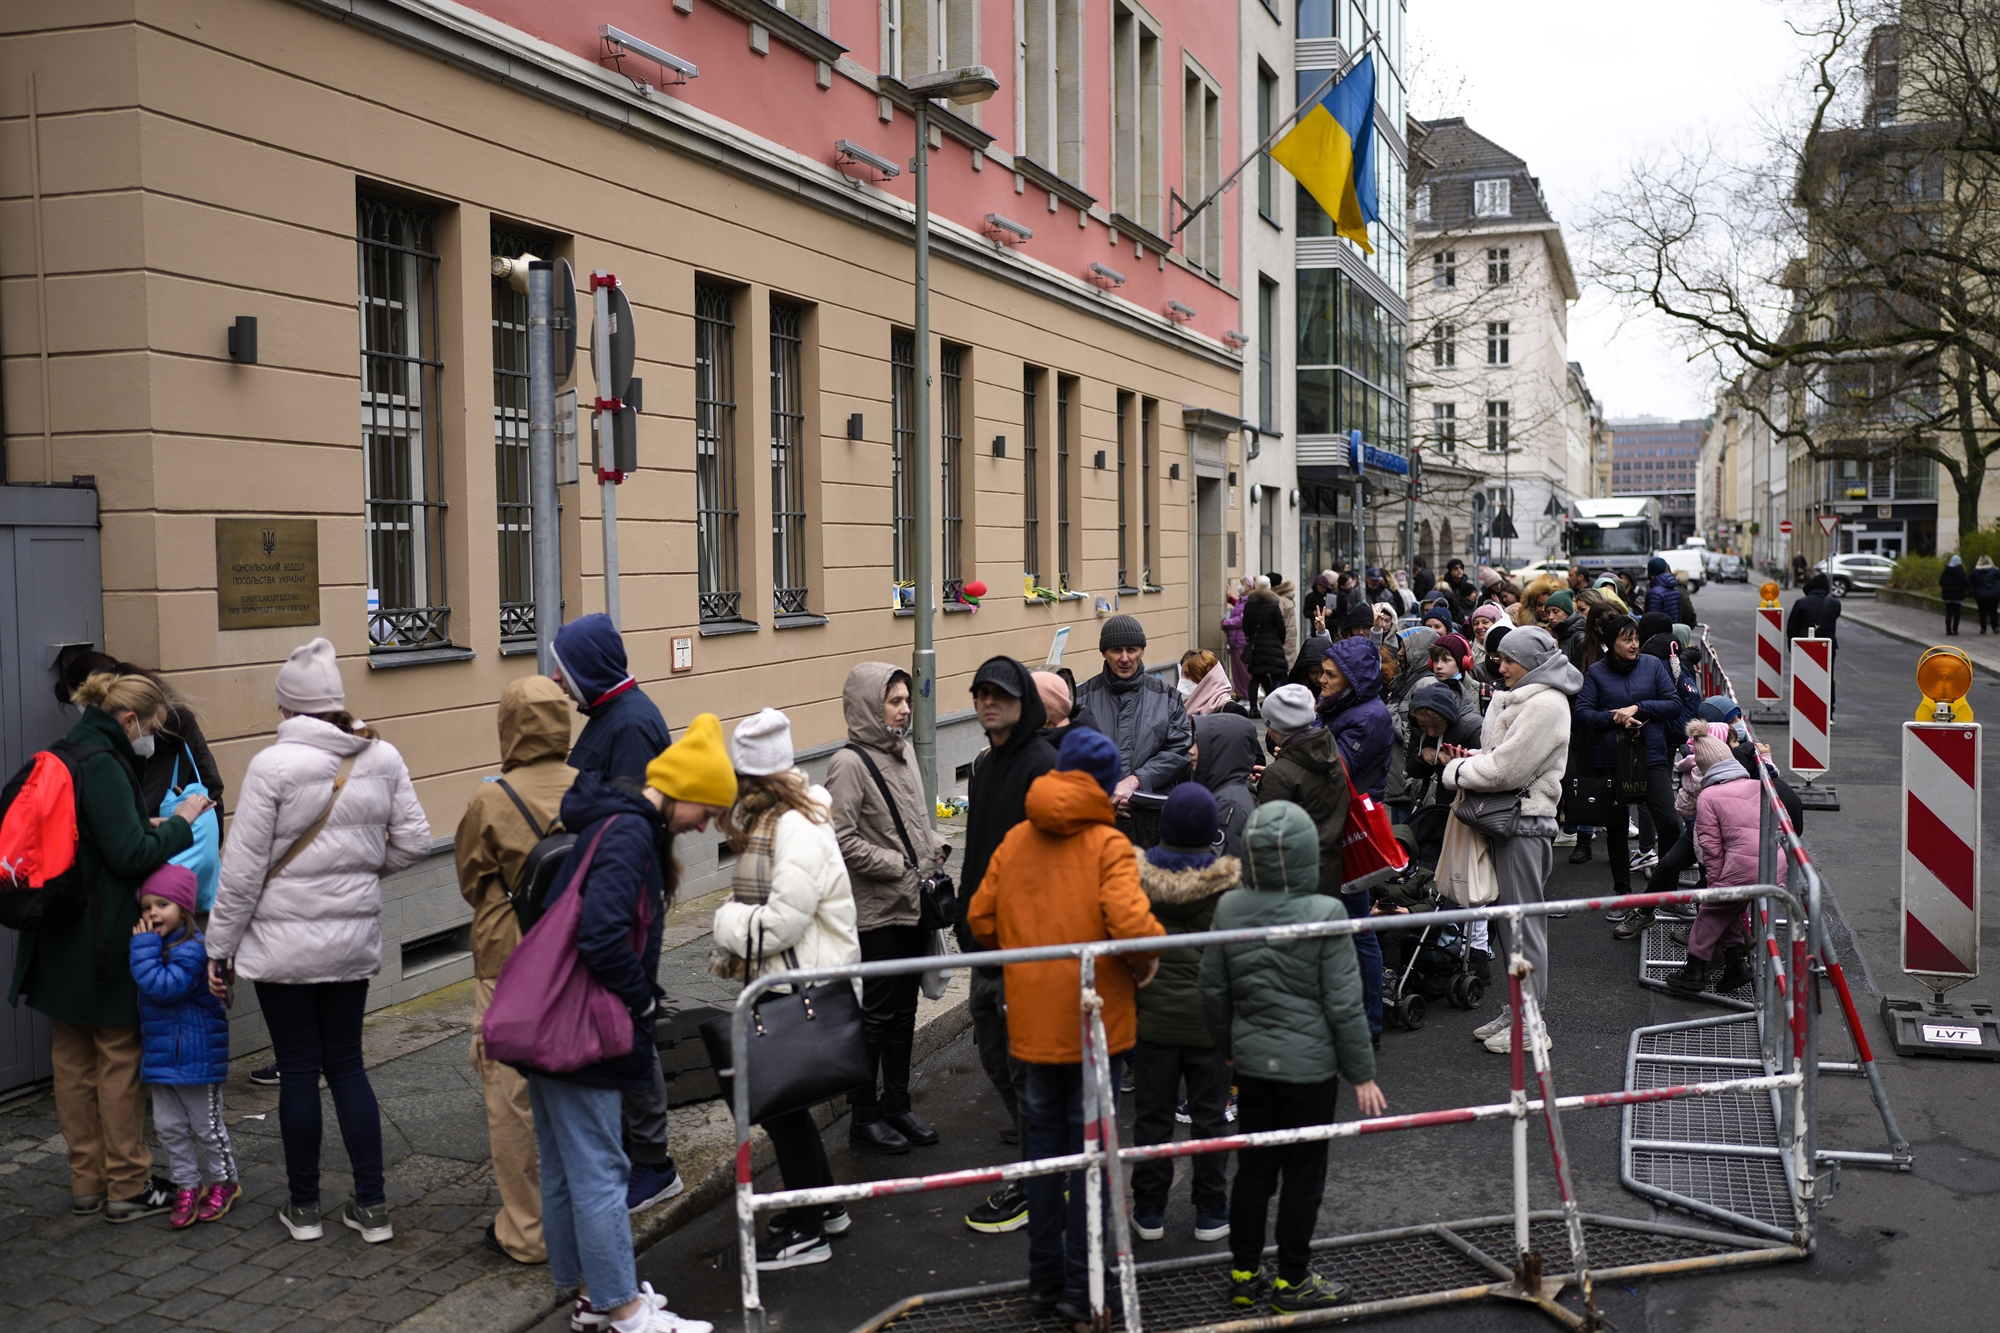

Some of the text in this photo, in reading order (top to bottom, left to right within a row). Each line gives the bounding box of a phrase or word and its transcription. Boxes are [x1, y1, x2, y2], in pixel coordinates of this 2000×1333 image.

[232, 562, 281, 573] КОНСУЛЬСЬКИЙ
[232, 574, 306, 585] ПОСОЛЬСТВА УКРАЇНИ
[240, 594, 300, 603] KONSULARABTEILUNG
[229, 604, 311, 615] DER BOTSCHAFT DER UKRAINE
[1935, 1030, 1968, 1039] LVT
[147, 1190, 167, 1206] N
